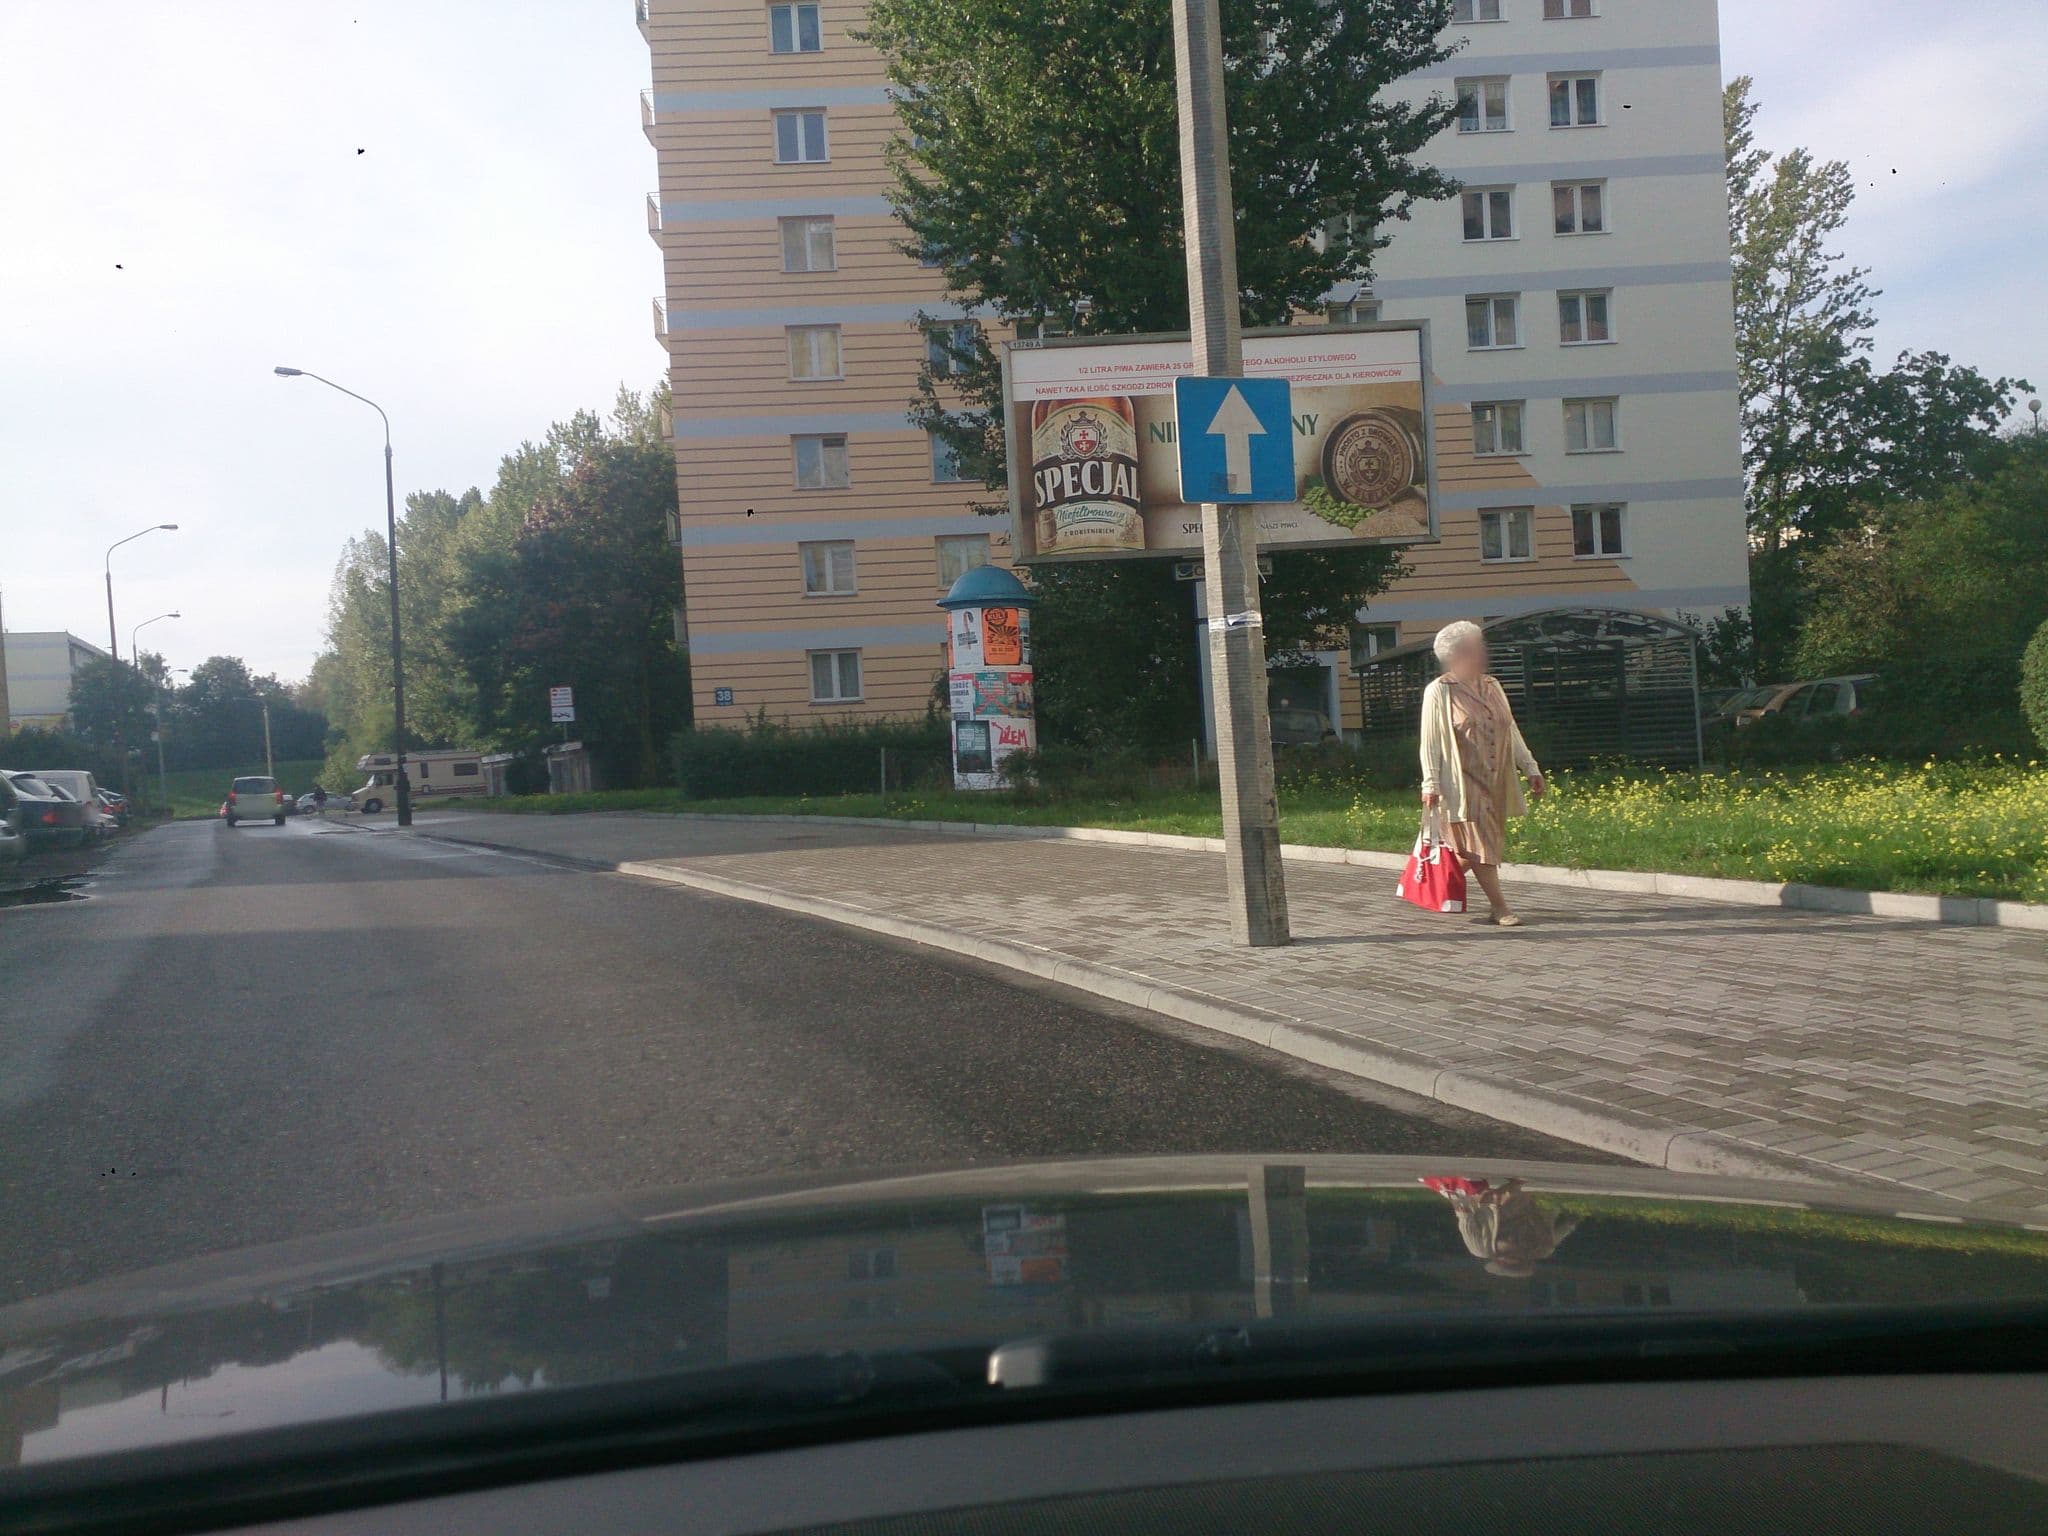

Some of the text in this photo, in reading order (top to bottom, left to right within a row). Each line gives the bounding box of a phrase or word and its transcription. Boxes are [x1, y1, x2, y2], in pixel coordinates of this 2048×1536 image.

[1090, 366, 1112, 374] LITRA
[1114, 365, 1134, 373] PIWA
[1135, 363, 1171, 372] ZAWIERA
[1172, 362, 1182, 370] 25
[1241, 359, 1263, 367] TEGO
[1264, 356, 1307, 365] ALKOHOLU
[1308, 353, 1357, 363] ETYLOWEGO
[1035, 386, 1062, 395] NAWET
[1111, 382, 1145, 392] SZKODZI
[1146, 381, 1174, 390] ZDROW
[1335, 372, 1351, 380] DLA
[716, 690, 732, 701] 38
